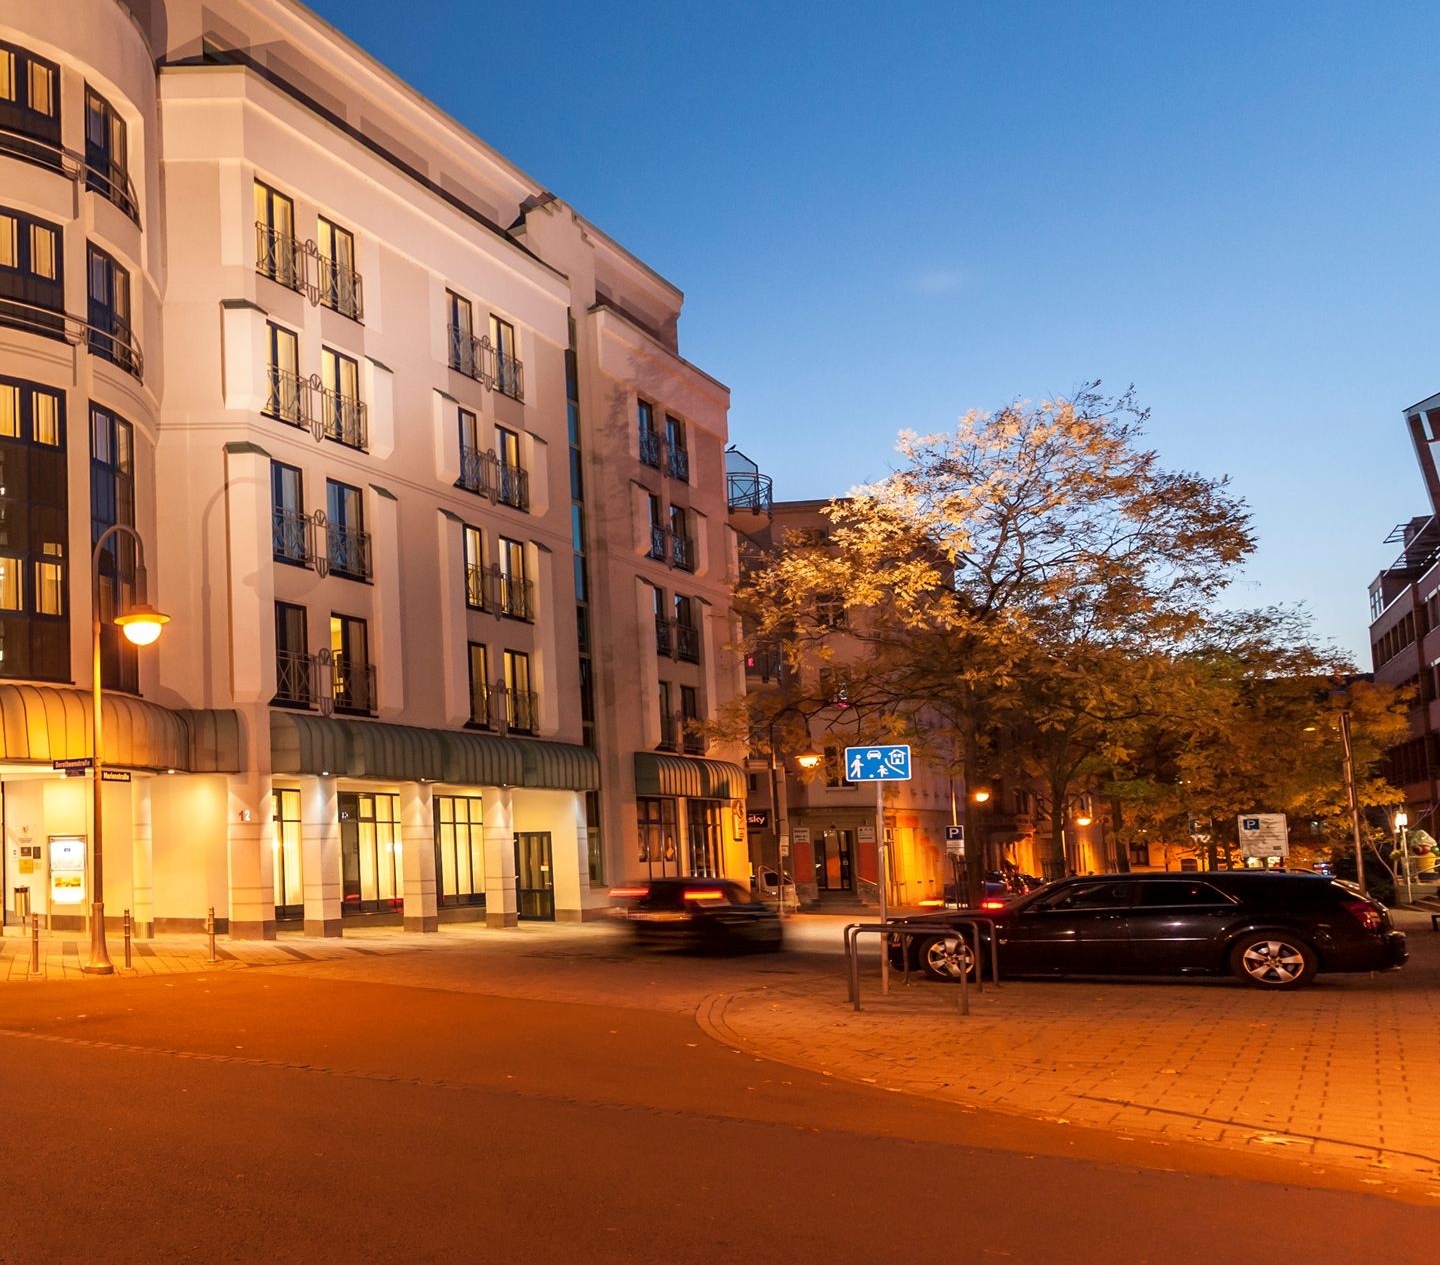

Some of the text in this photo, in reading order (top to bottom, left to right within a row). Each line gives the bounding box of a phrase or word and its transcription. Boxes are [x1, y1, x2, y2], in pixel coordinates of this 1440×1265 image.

[239, 810, 251, 822] 12
[748, 815, 765, 825] sky
[1247, 820, 1256, 829] P
[949, 828, 959, 838] P
